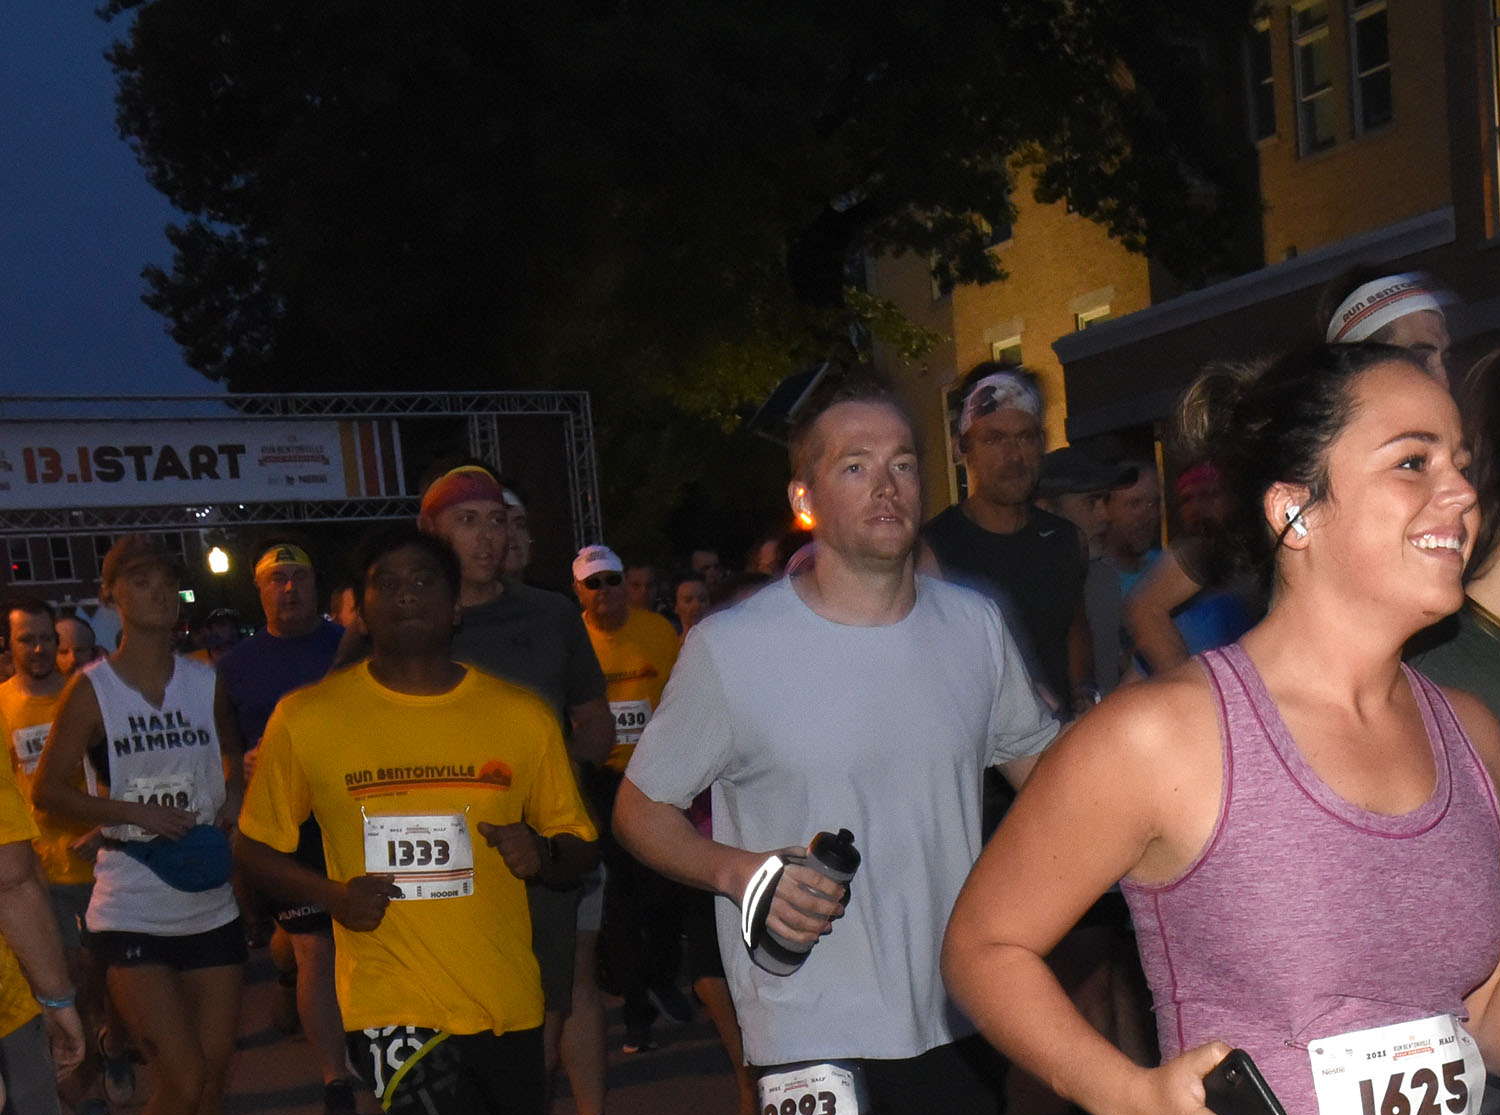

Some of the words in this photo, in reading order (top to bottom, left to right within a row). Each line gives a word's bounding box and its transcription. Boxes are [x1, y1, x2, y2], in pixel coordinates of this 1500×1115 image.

[1343, 302, 1366, 323] RUN
[23, 446, 92, 484] 13.1
[93, 444, 246, 483] START
[128, 710, 192, 734] HAIL
[616, 711, 646, 727] 430
[114, 729, 211, 758] NIMROD
[344, 768, 373, 786] RUN
[376, 764, 476, 782] BENTONVILLE
[387, 839, 450, 867] 1333
[430, 890, 459, 898] HOODIE
[1366, 1049, 1388, 1061] 2021
